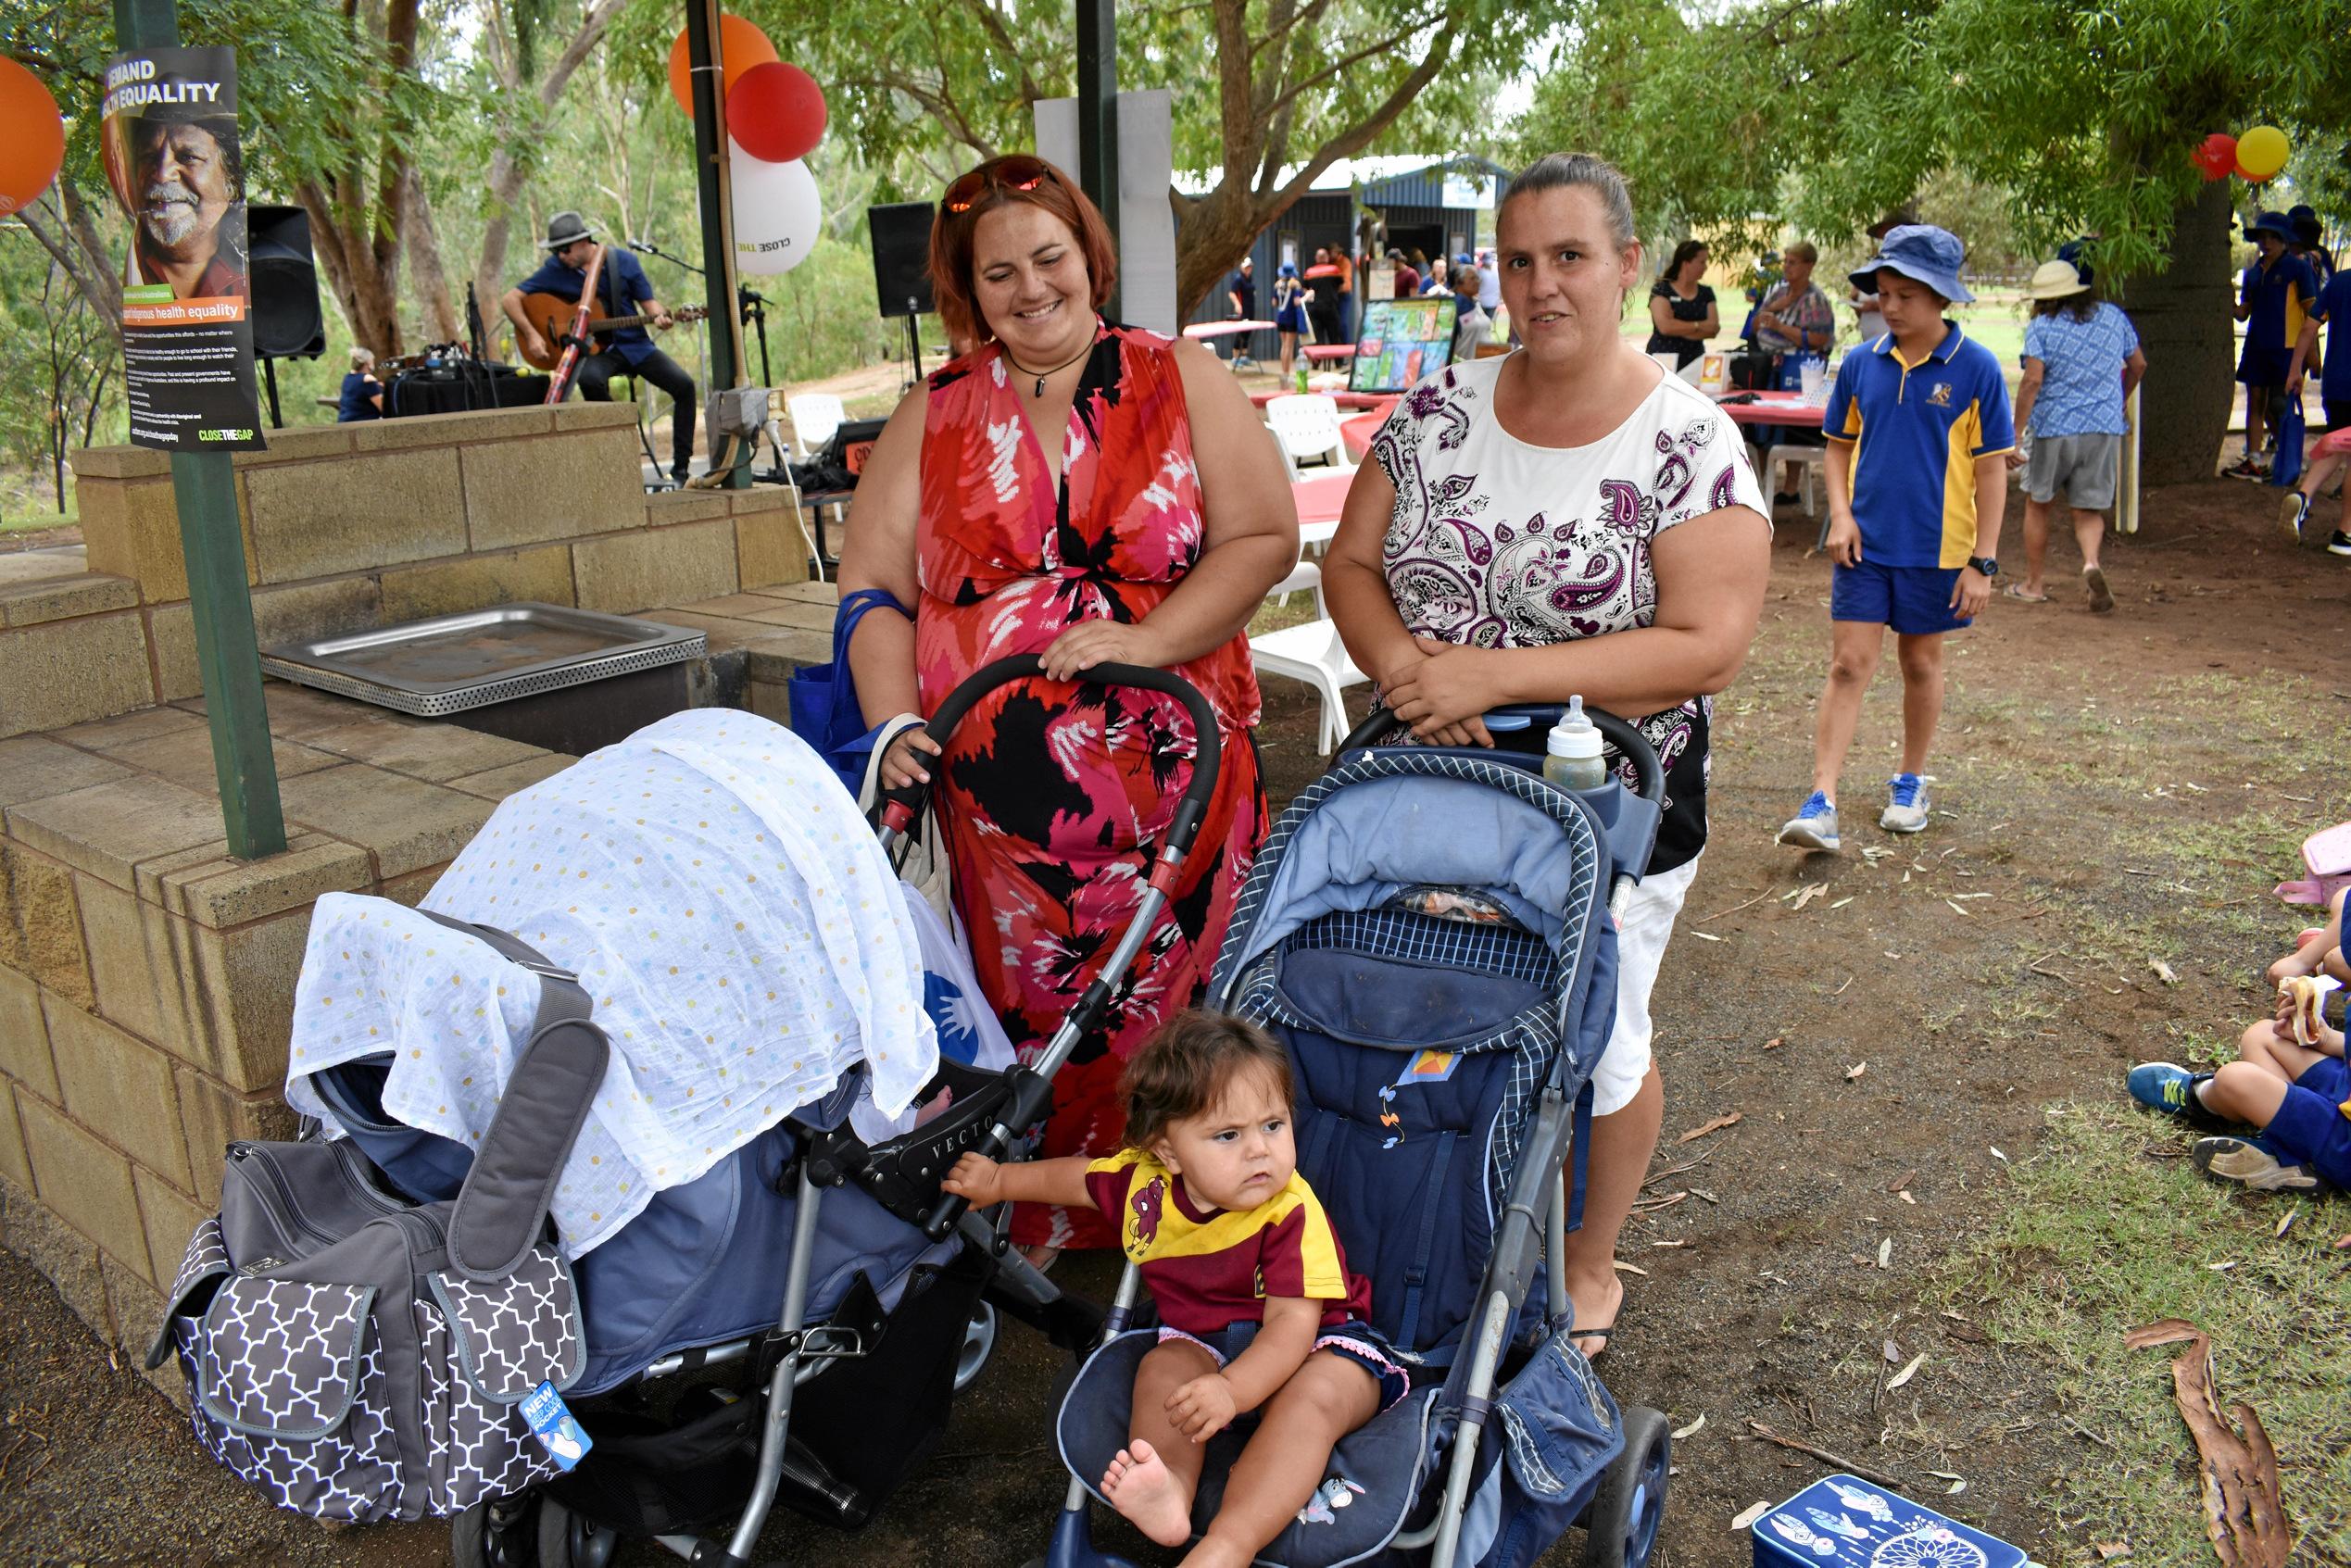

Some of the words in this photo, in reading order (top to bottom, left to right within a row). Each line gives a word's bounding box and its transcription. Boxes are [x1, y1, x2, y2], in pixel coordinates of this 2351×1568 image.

[119, 82, 221, 108] EQUALITY
[759, 237, 791, 253] CLOSE
[156, 306, 185, 320] health
[188, 304, 238, 320] equality
[932, 1115, 993, 1159] VECTO
[524, 1386, 553, 1418] NEW
[530, 1409, 544, 1424] KEEP
[534, 1402, 562, 1431] POCKET
